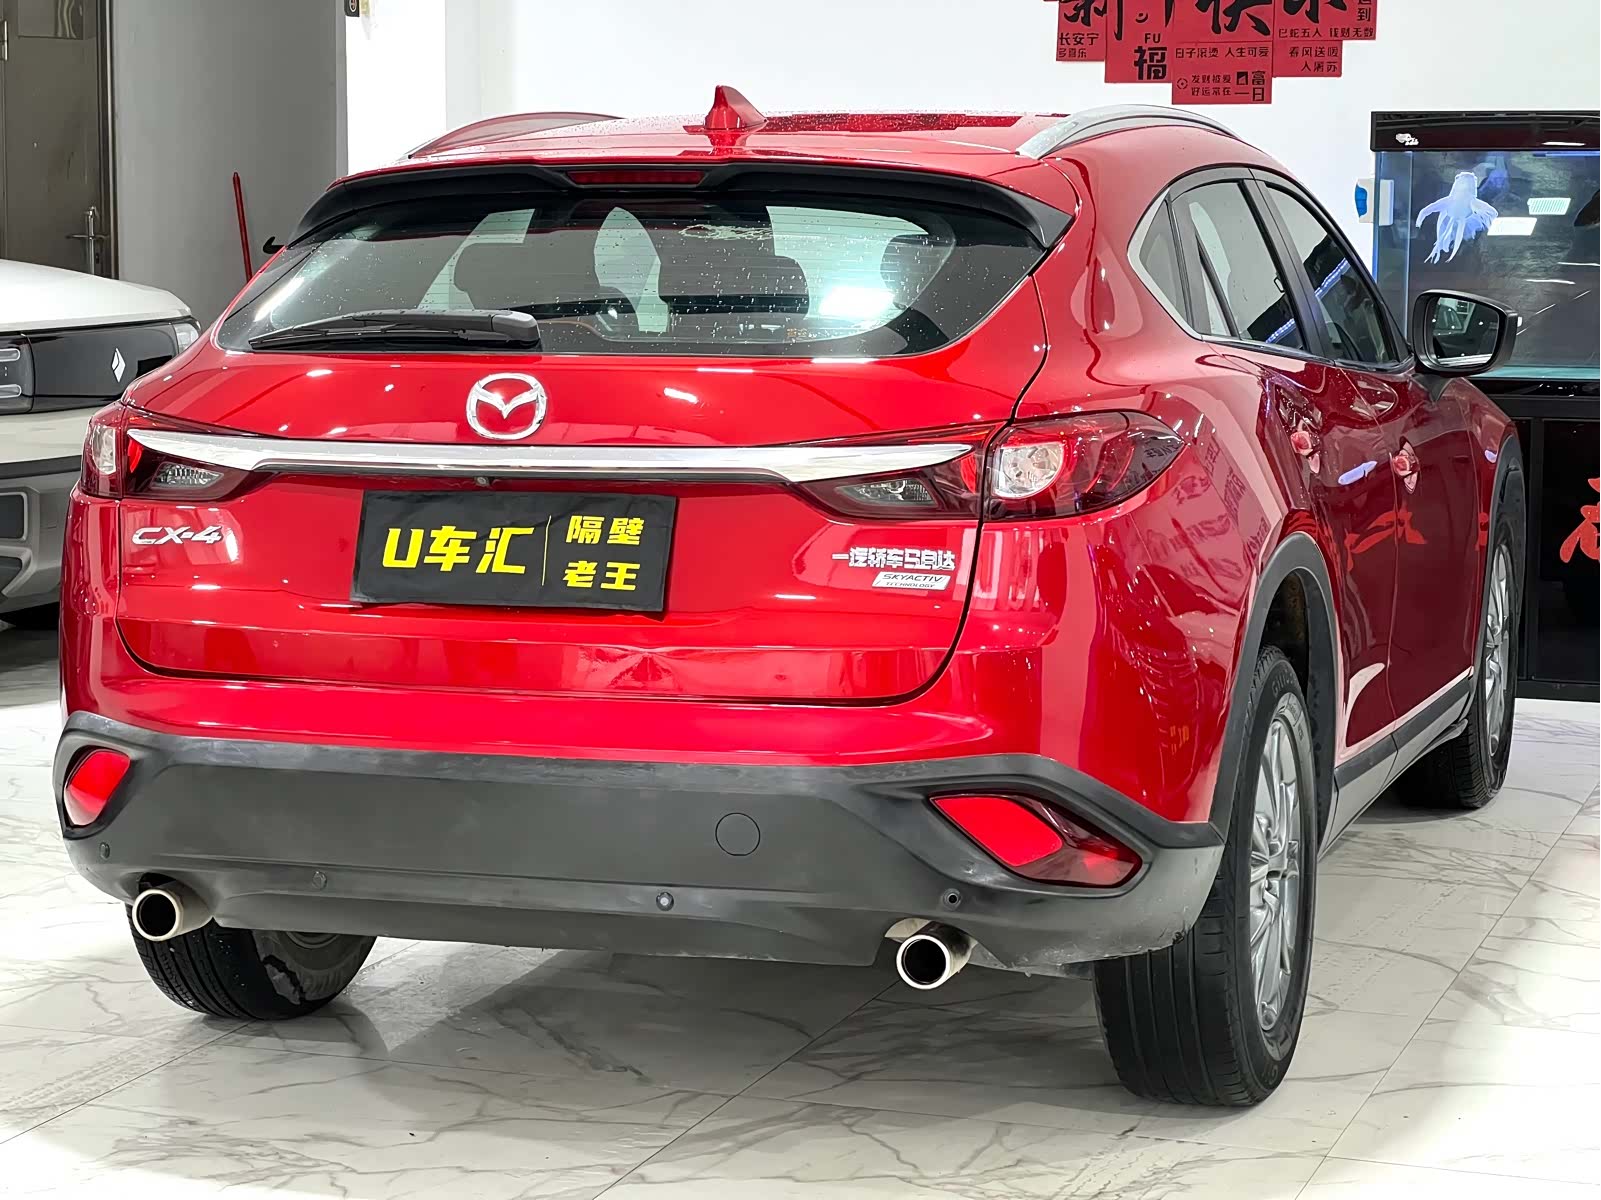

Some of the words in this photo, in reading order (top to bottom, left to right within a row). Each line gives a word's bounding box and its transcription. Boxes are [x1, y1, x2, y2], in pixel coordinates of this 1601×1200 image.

[1144, 33, 1161, 44] FU
[1134, 46, 1167, 80] 福
[1175, 47, 1219, 59] 日子滚烫
[1225, 47, 1269, 58] 人生可爱
[131, 525, 223, 545] CX-4
[565, 515, 645, 546] 隔壁
[563, 560, 641, 591] 老王
[882, 573, 943, 582] SKYACTIV
